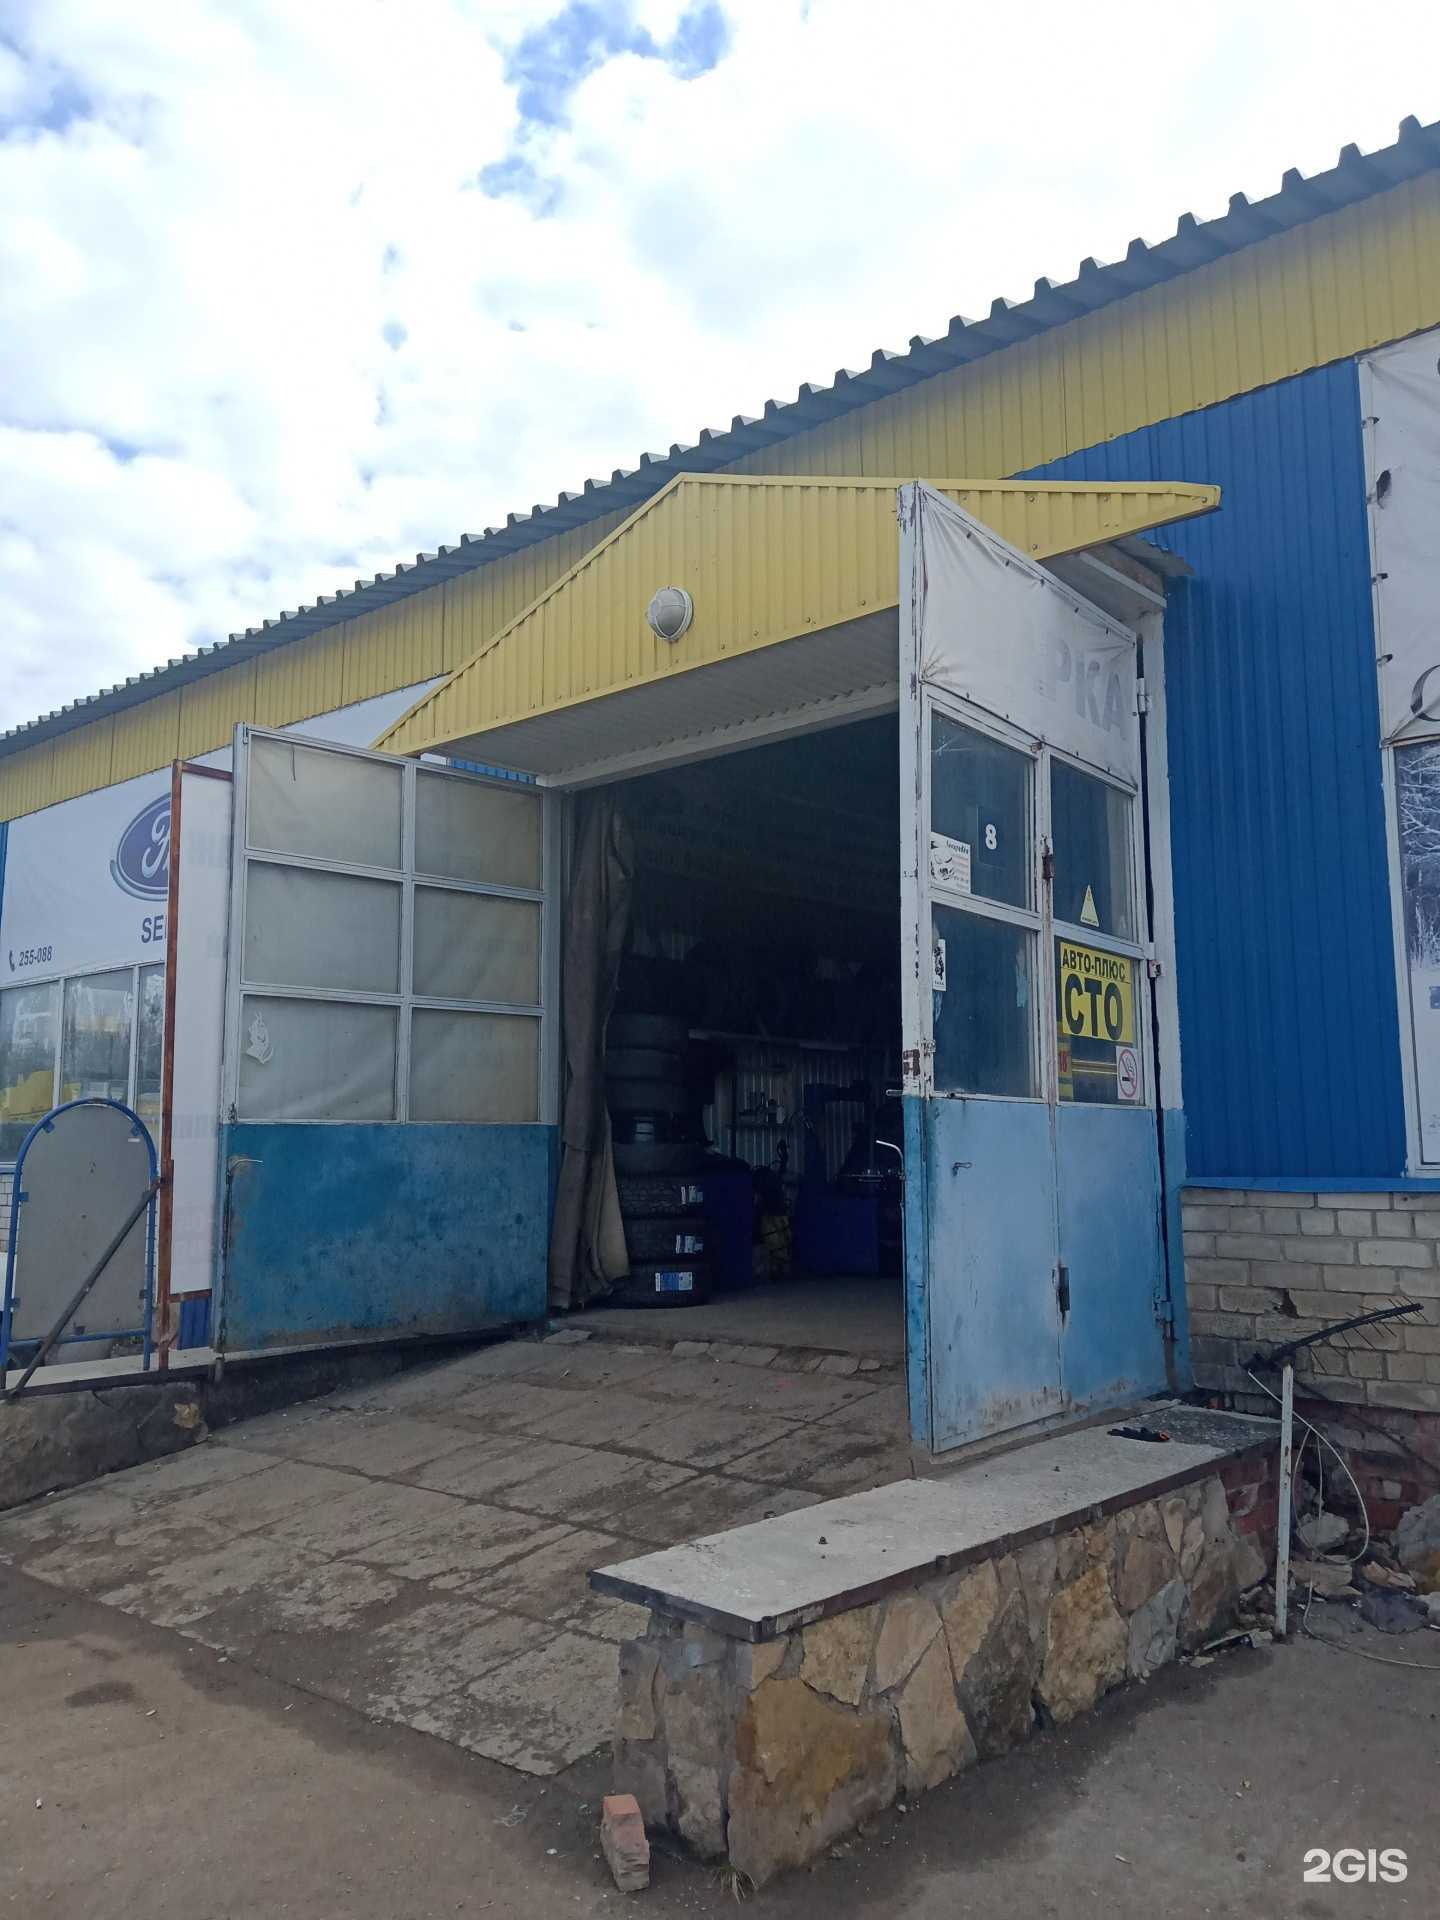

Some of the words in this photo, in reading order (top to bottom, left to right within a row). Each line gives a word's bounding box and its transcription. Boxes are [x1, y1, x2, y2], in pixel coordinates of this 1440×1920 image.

[985, 824, 997, 850] 8
[19, 945, 53, 966] 255-088
[1062, 949, 1126, 982] АВТО-ПЛЮС
[1064, 973, 1123, 1041] СТО
